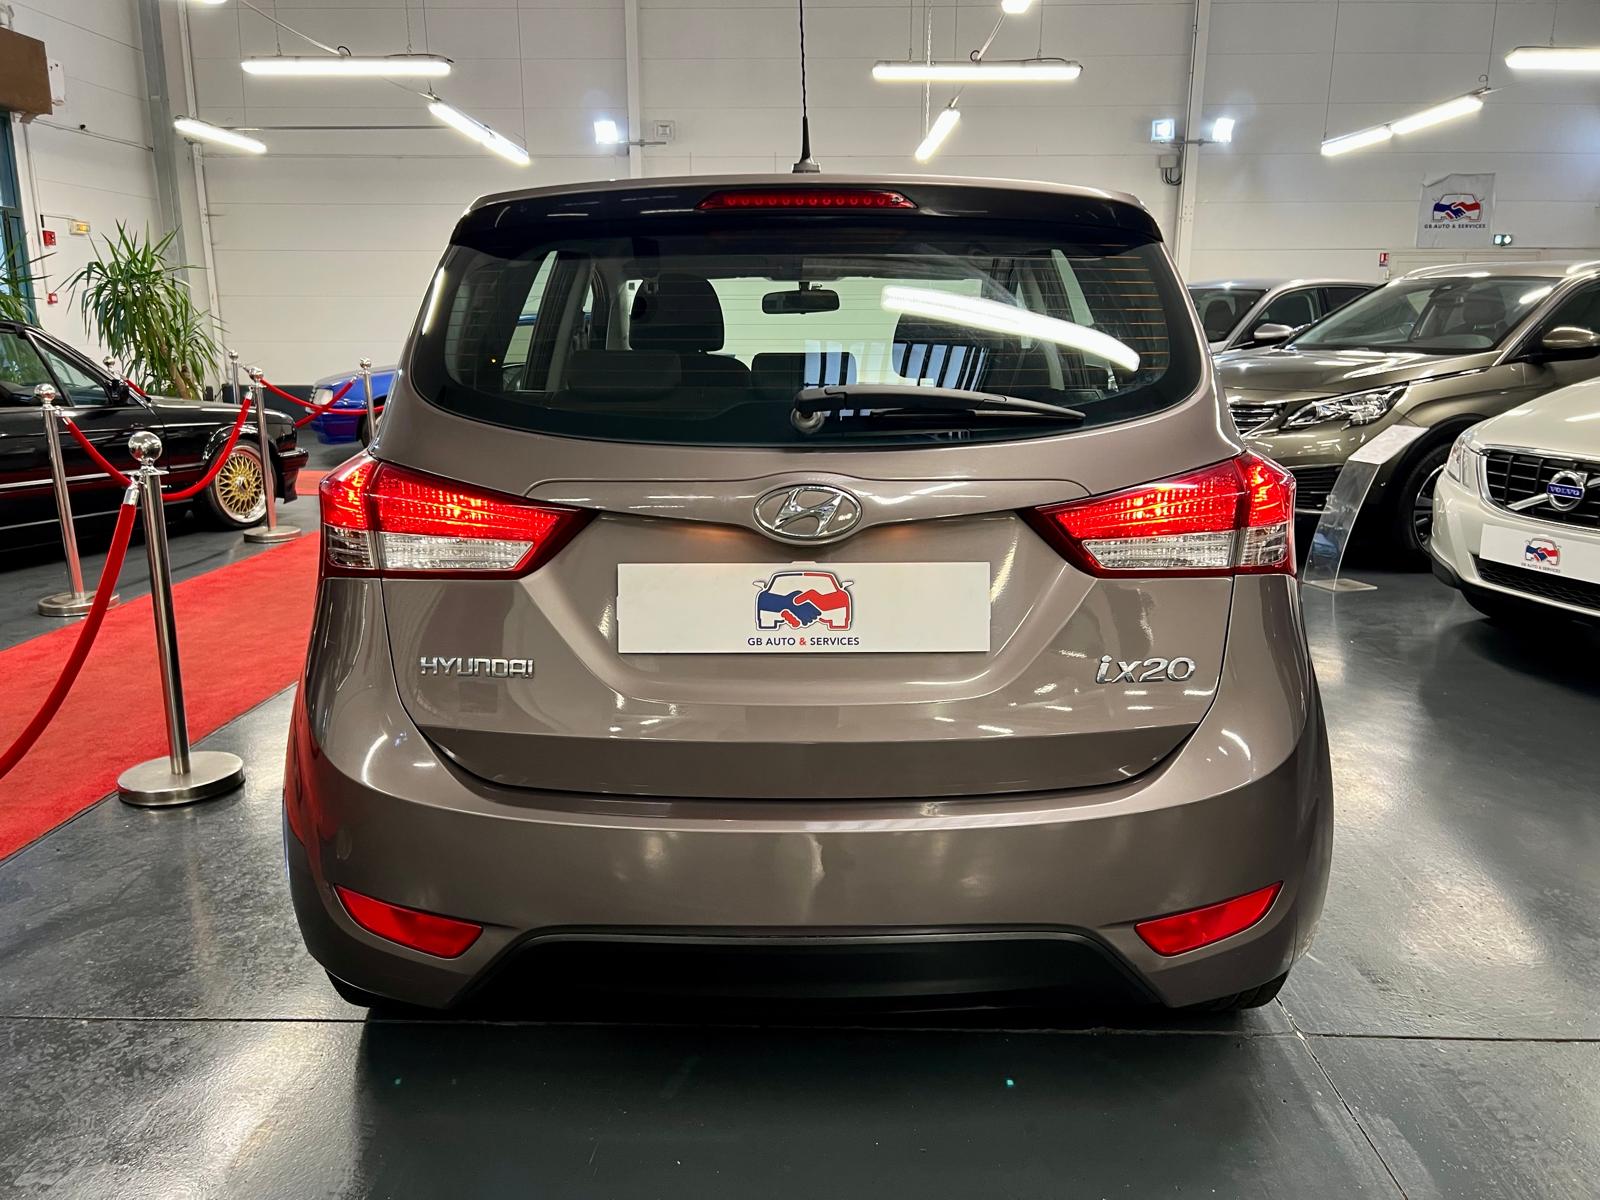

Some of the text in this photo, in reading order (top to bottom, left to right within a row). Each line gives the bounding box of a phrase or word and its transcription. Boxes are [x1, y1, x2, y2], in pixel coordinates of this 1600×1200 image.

[1550, 486, 1580, 496] VOLVO
[747, 637, 860, 646] GB AUTO & SERVICES
[420, 656, 534, 679] HYUNDAI
[1096, 654, 1196, 684] ix20
